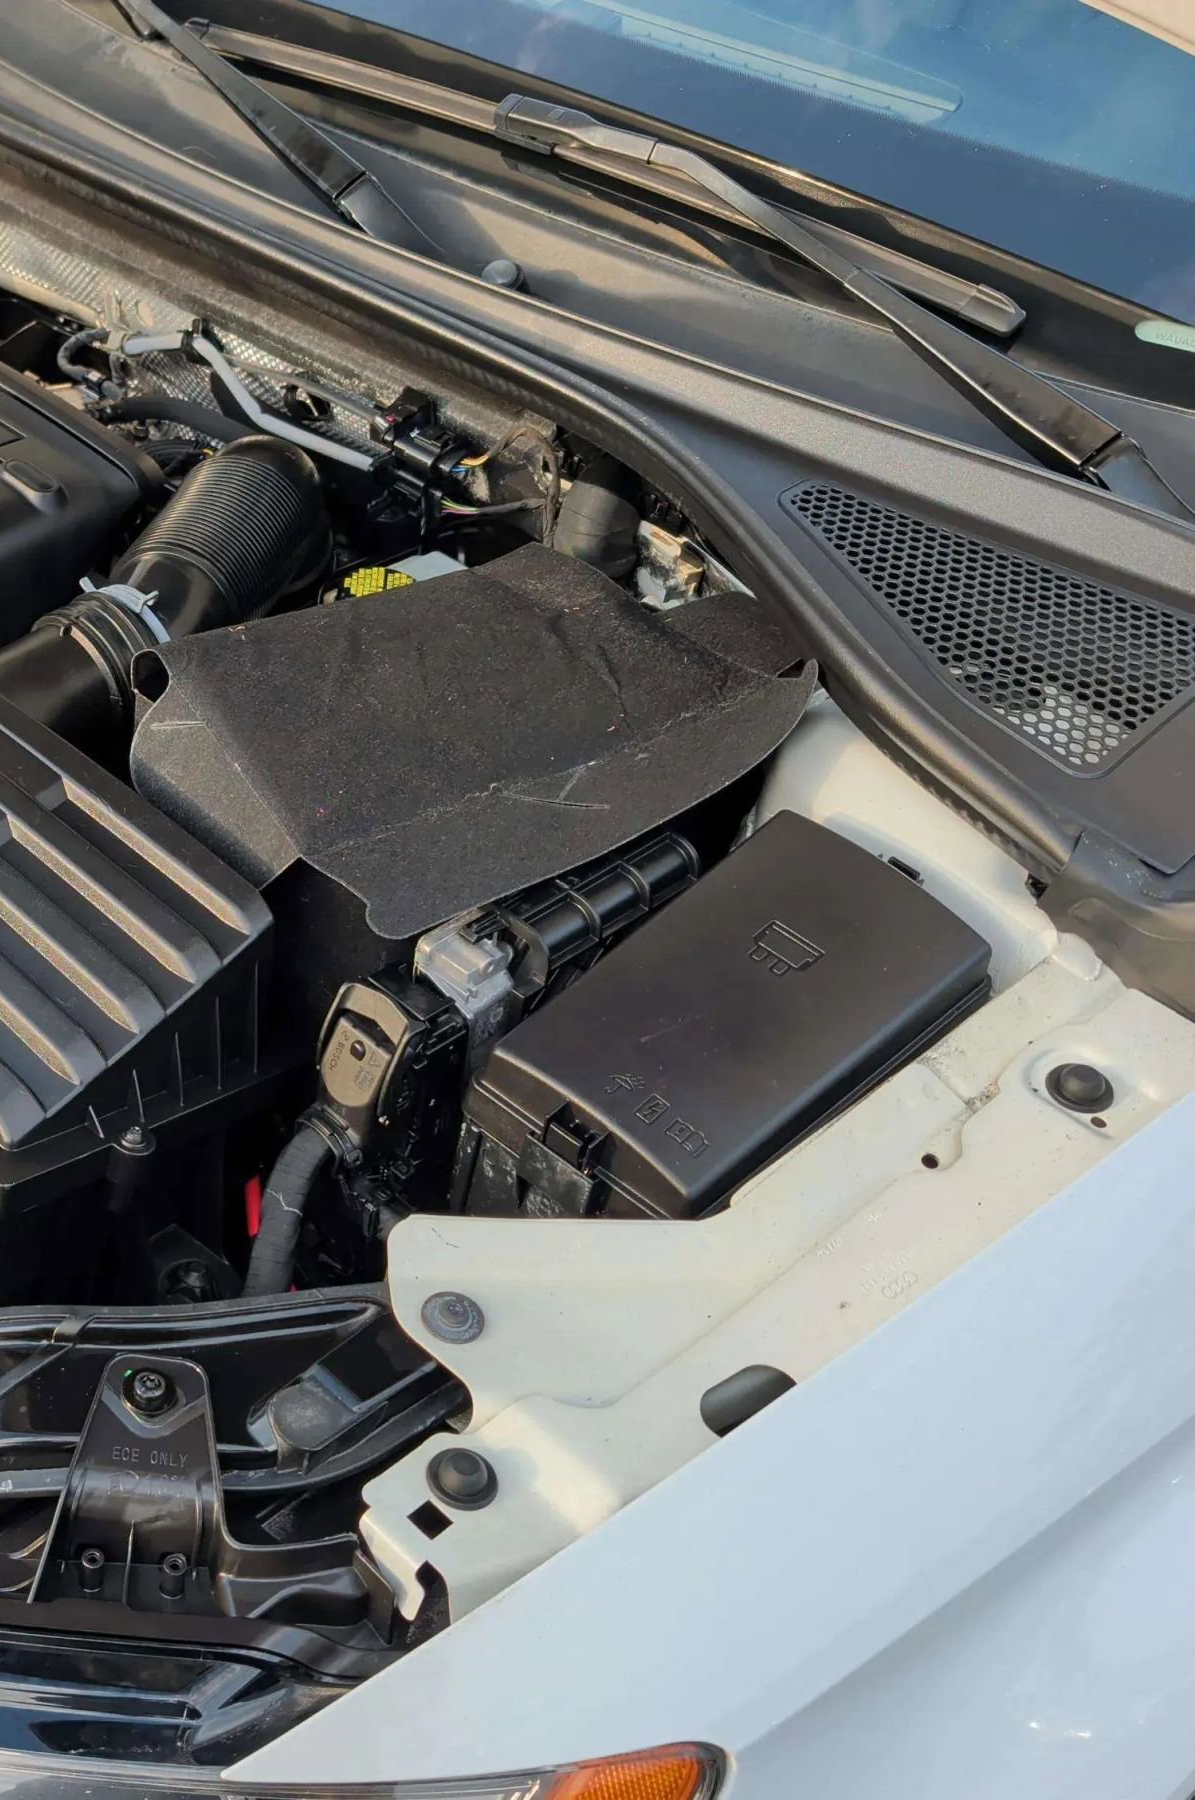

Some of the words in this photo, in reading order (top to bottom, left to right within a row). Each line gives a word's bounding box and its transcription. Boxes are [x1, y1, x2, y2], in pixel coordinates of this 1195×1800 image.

[328, 1042, 347, 1072] BOSCH
[111, 1445, 141, 1463] ECE
[149, 1449, 188, 1468] ONLY
